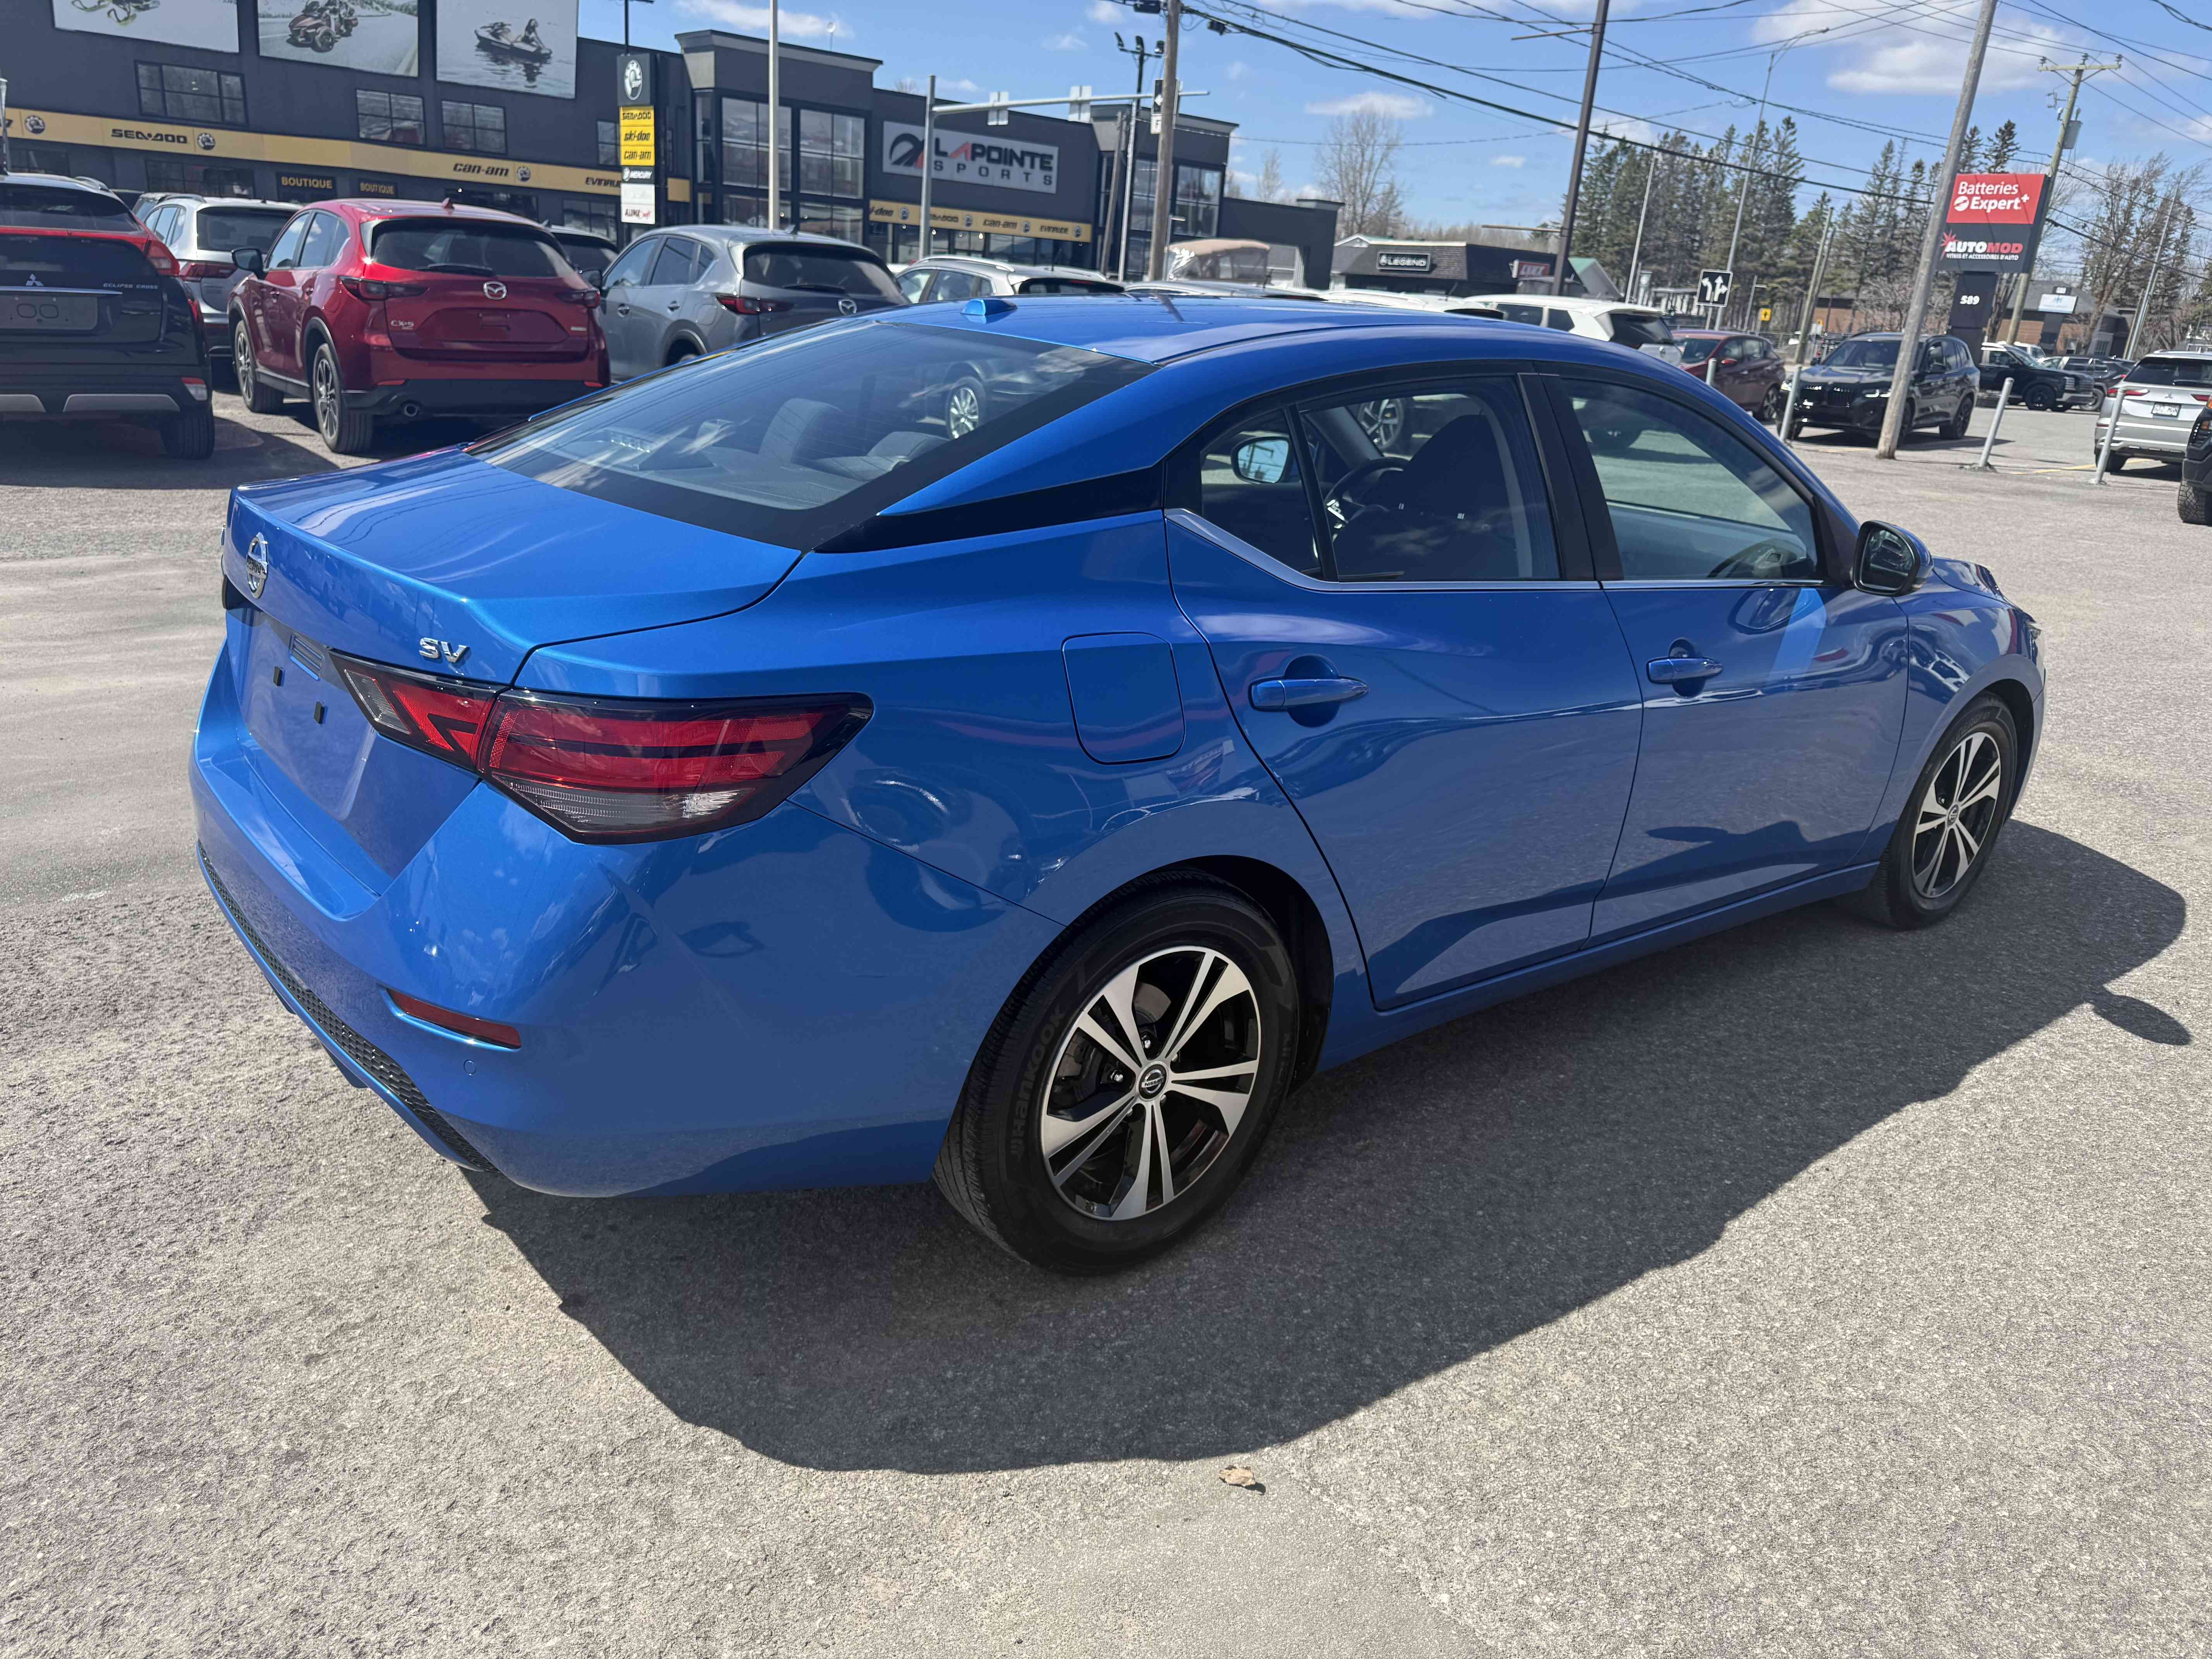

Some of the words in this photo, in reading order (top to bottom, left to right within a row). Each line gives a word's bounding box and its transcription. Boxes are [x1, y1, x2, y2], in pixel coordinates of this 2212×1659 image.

[624, 151, 651, 160] can-am
[934, 137, 1053, 172] LAPOINTE
[453, 163, 509, 177] can-am
[934, 160, 1053, 186] SPORTS
[281, 176, 333, 189] BOUTIQUE
[360, 182, 394, 195] BOUTIQUE
[1958, 181, 2019, 195] Batteries
[983, 219, 1018, 230] can-am
[419, 637, 467, 663] SV
